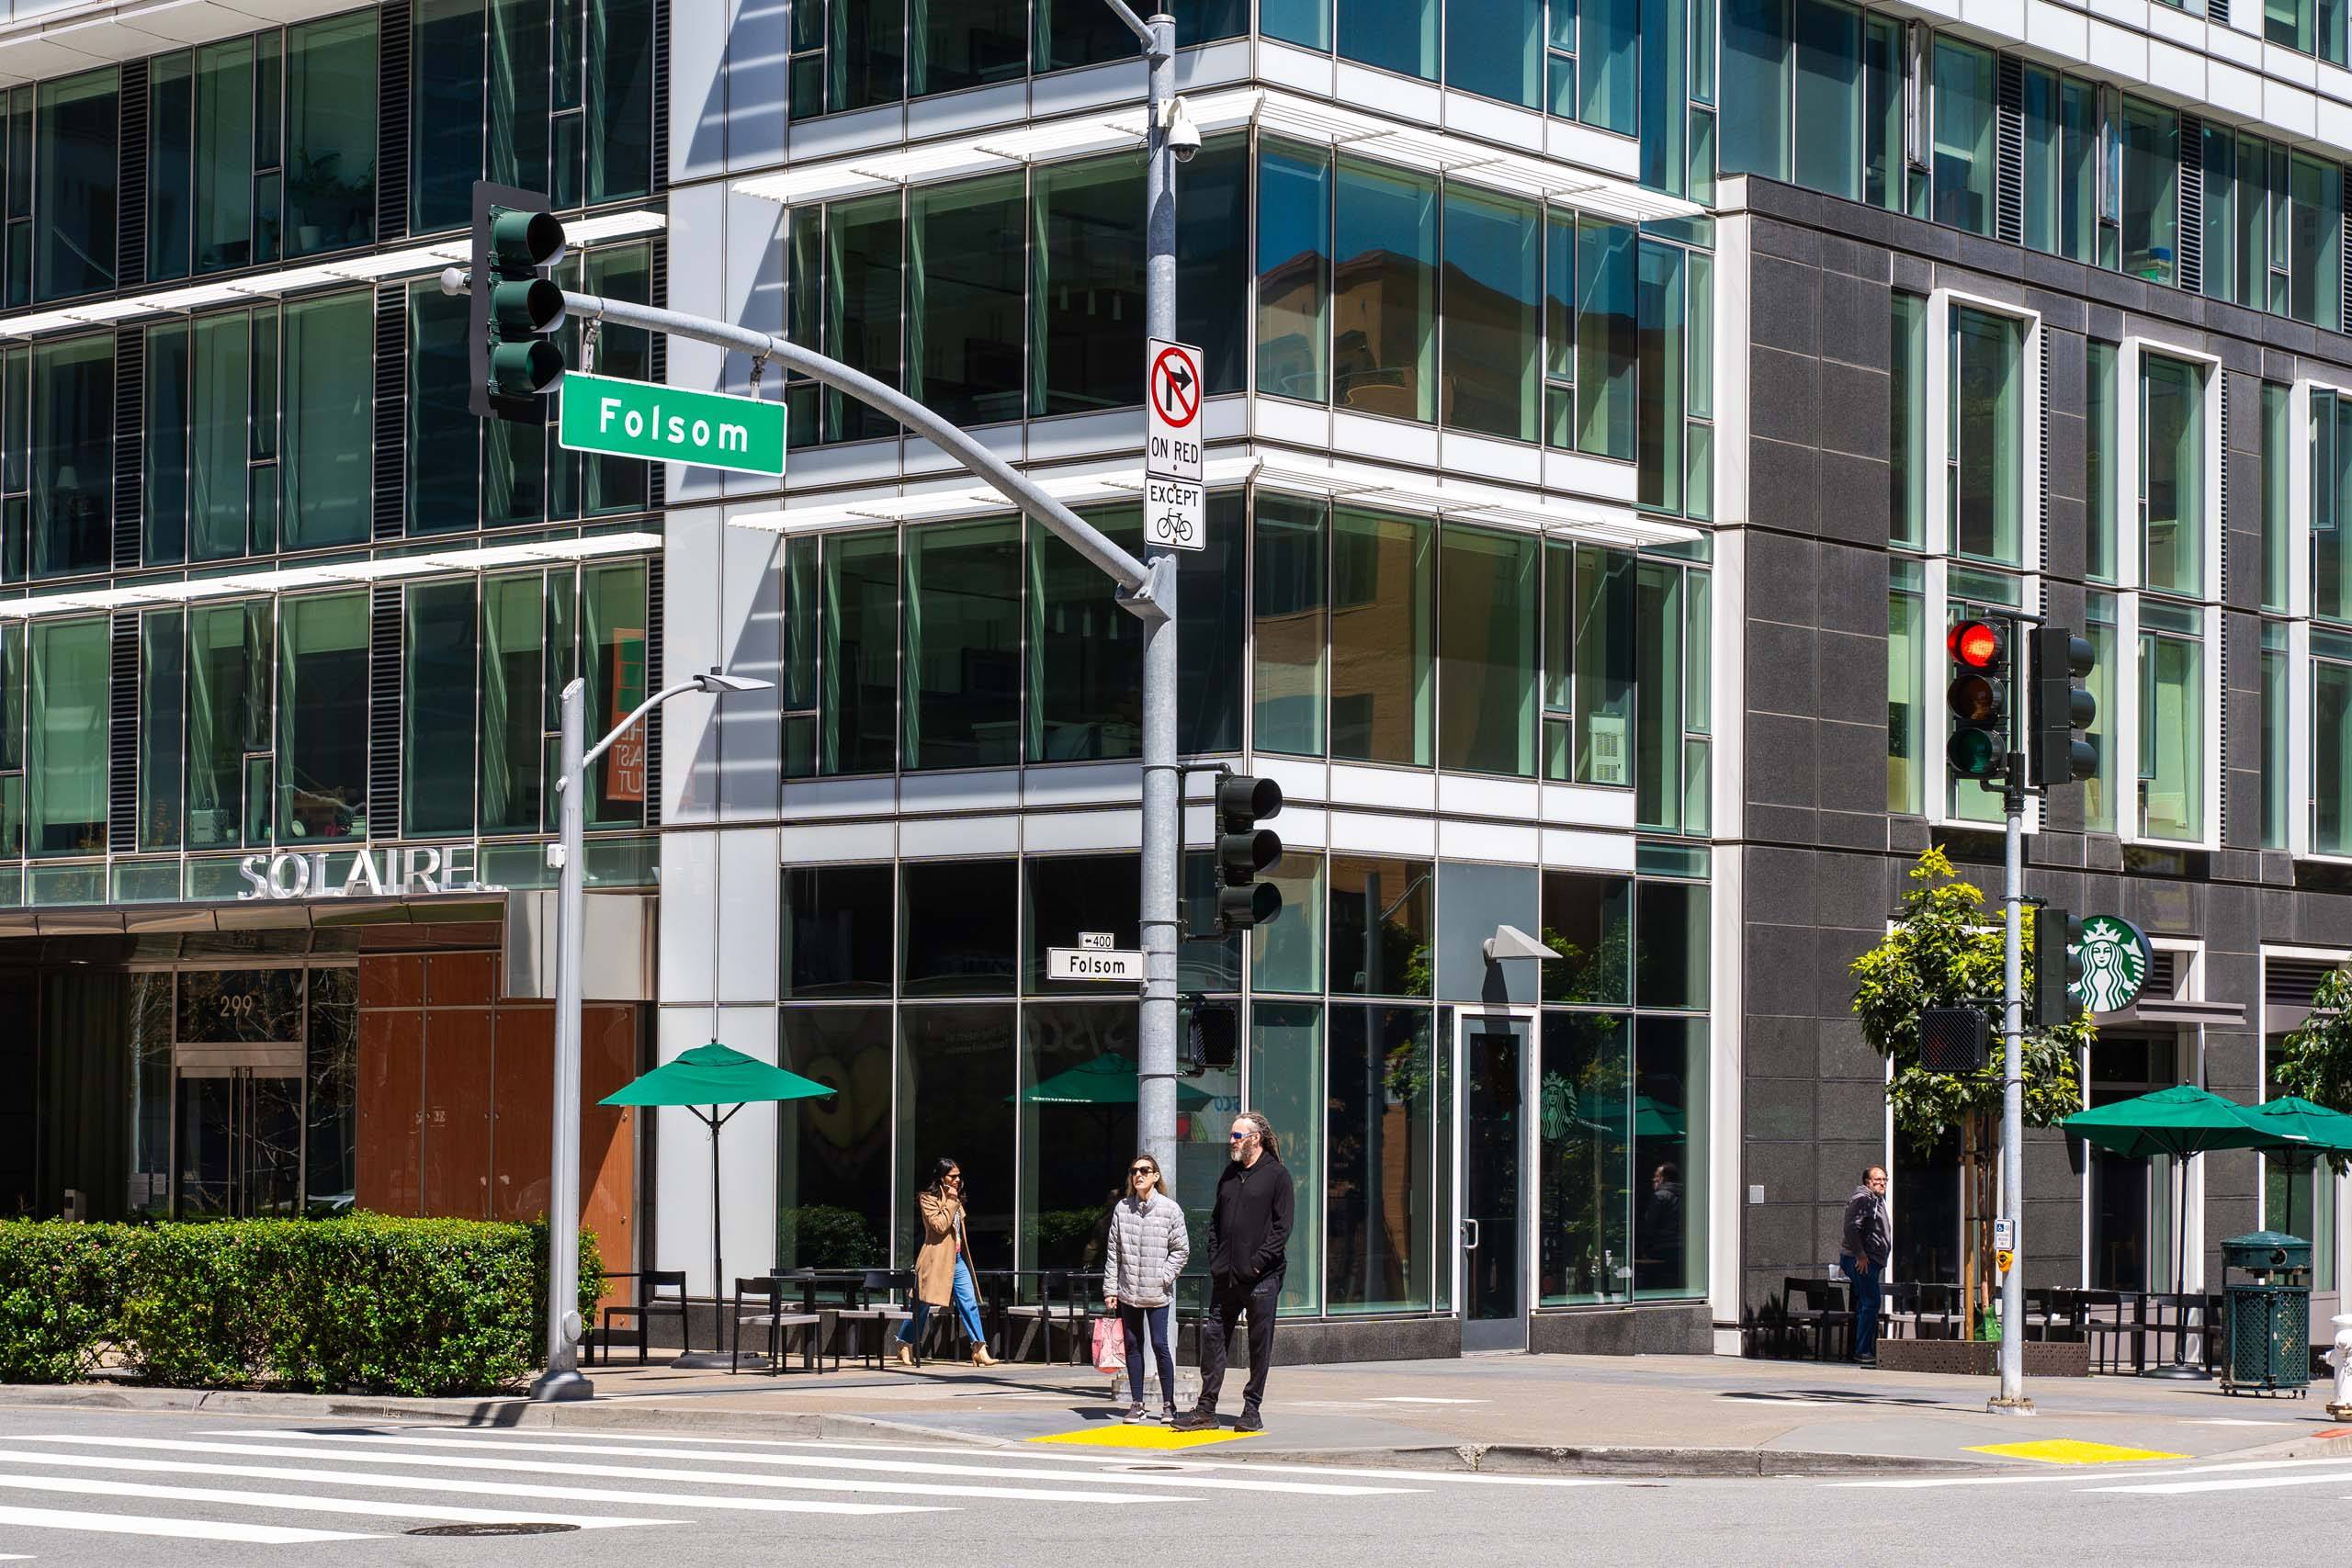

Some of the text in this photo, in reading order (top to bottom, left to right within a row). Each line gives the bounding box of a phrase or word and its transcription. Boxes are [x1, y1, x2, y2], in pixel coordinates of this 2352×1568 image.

[599, 396, 748, 453] Folsom
[1151, 436, 1199, 465] ON RED
[1150, 485, 1199, 508] EXCEPT
[237, 844, 479, 900] SOLAIRE
[1093, 935, 1112, 947] 400
[1069, 955, 1125, 974] Folsom
[220, 995, 253, 1017] 299
